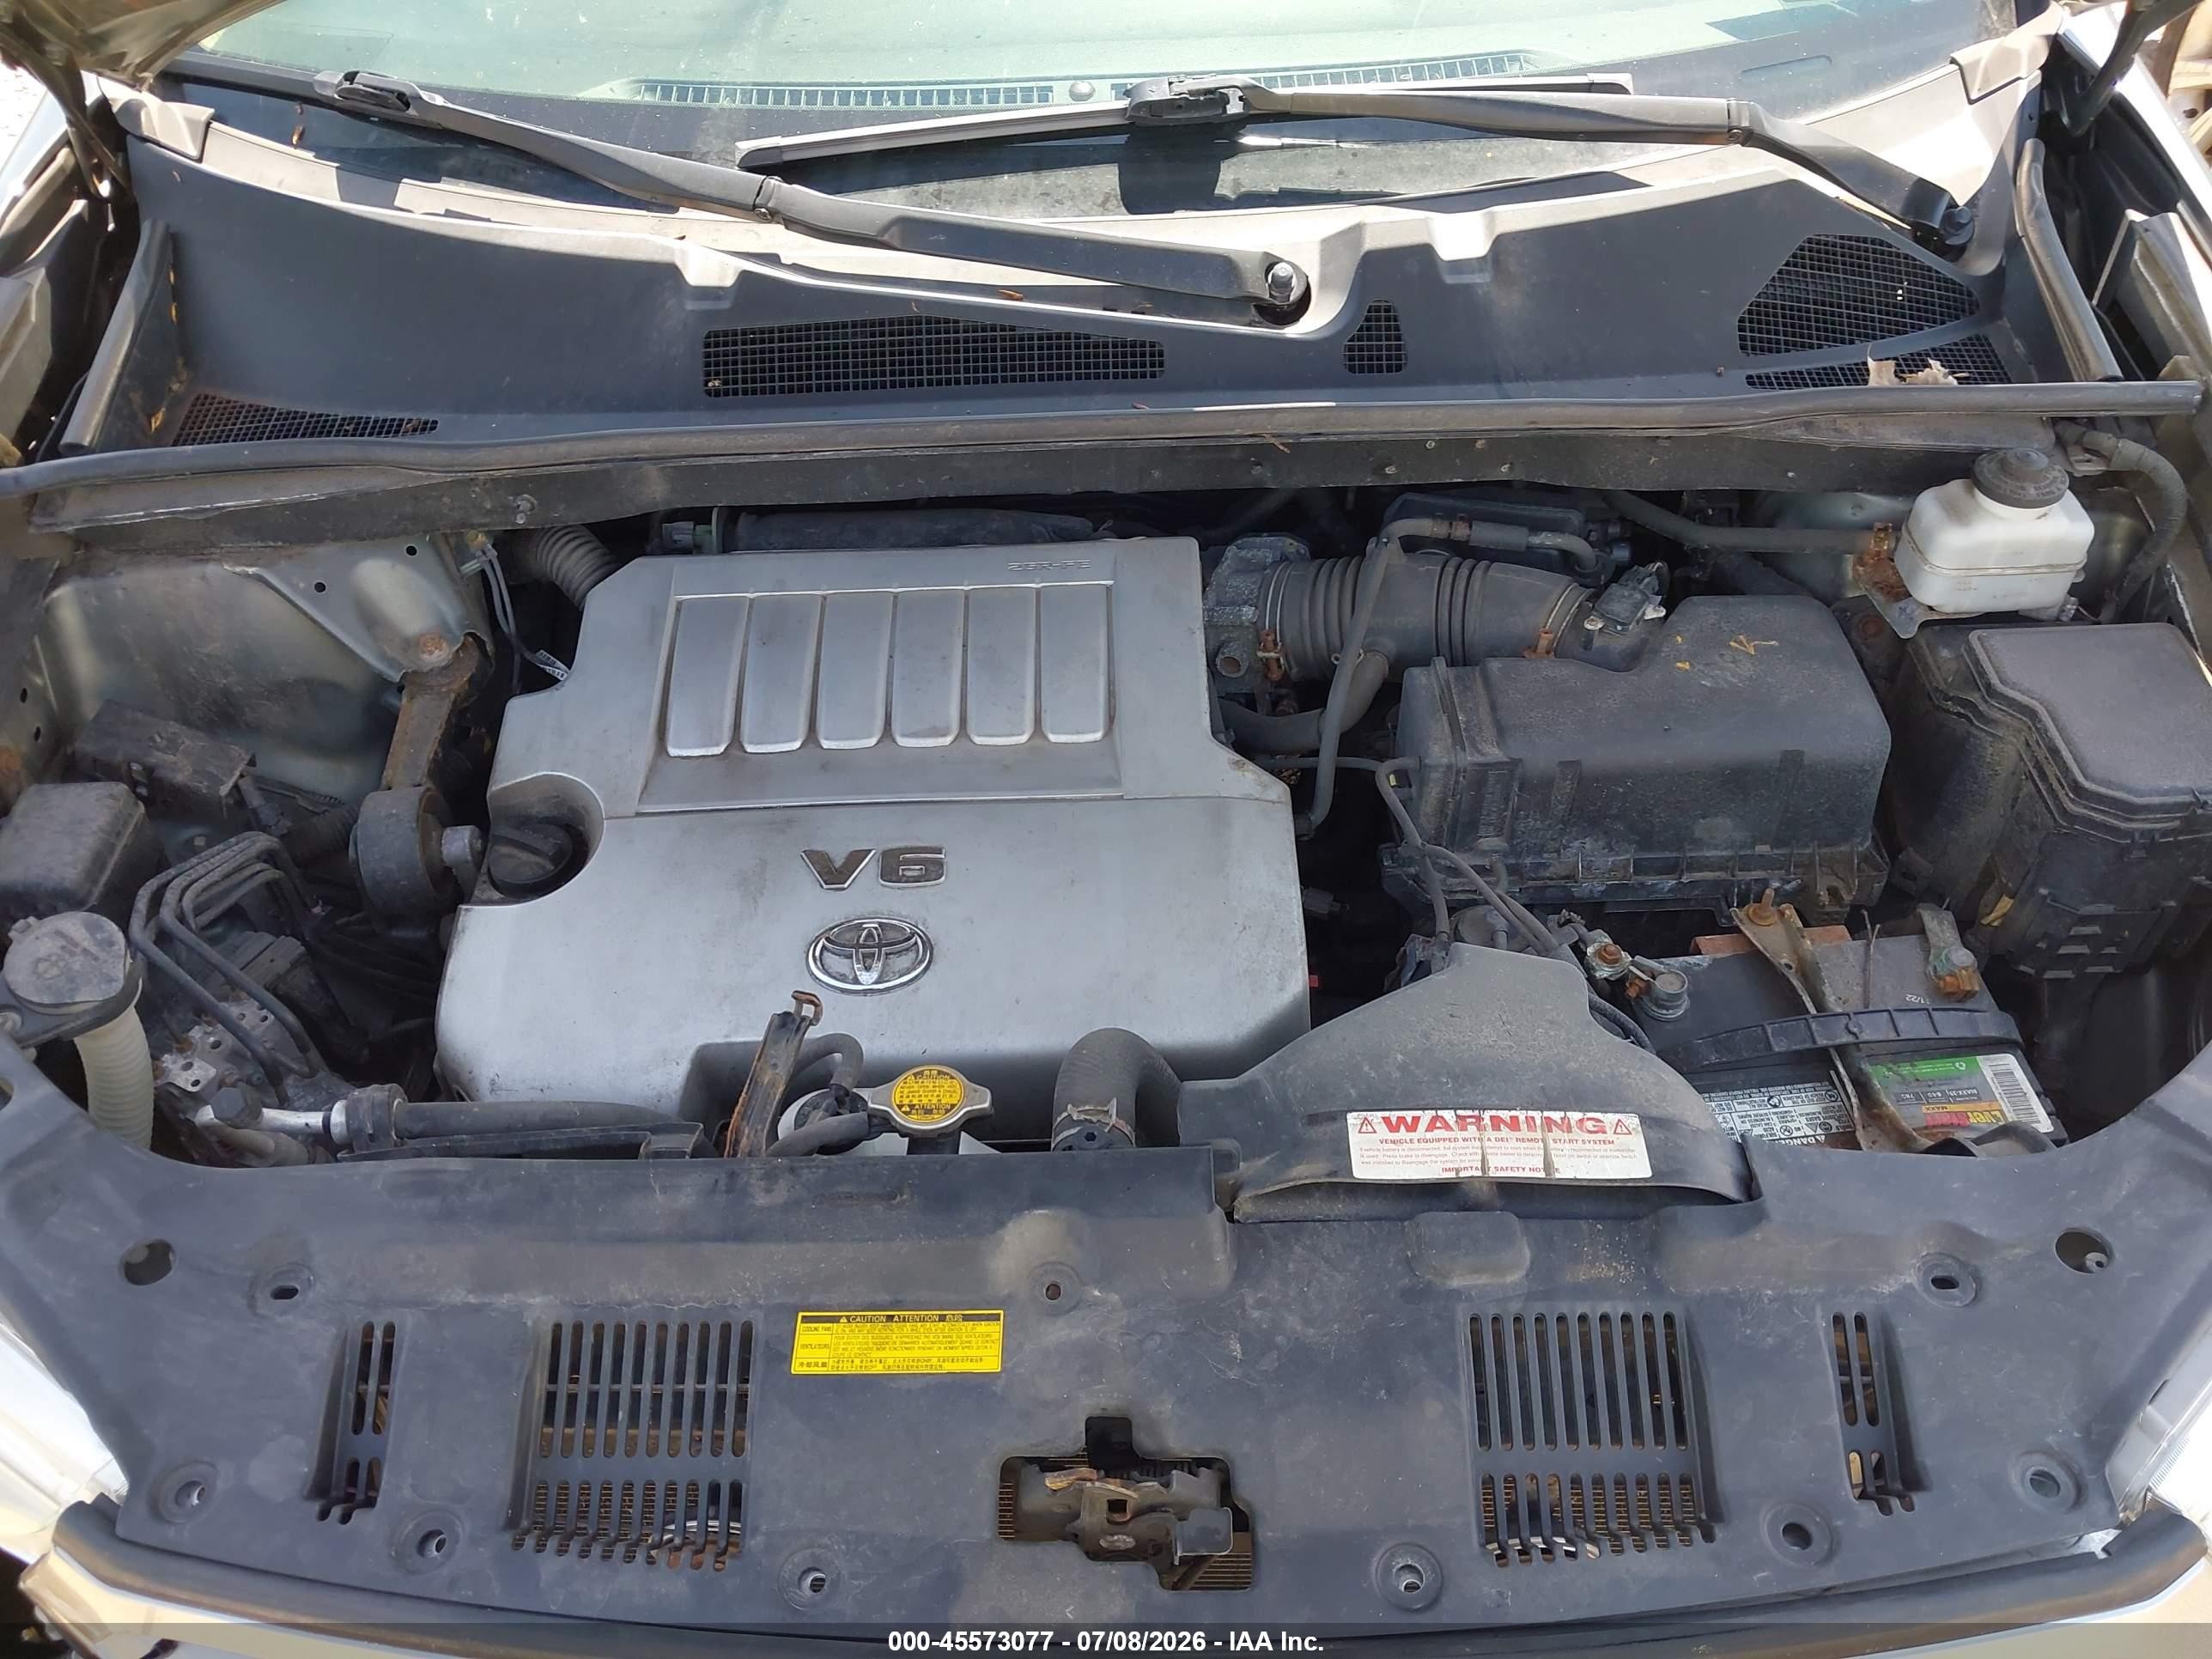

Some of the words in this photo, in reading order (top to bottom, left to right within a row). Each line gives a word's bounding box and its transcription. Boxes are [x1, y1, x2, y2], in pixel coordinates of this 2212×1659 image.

[800, 845, 946, 890] V6
[1381, 1115, 1607, 1134] WARNING
[849, 1315, 886, 1323] CAUTION
[893, 1314, 939, 1322] ATTENTION
